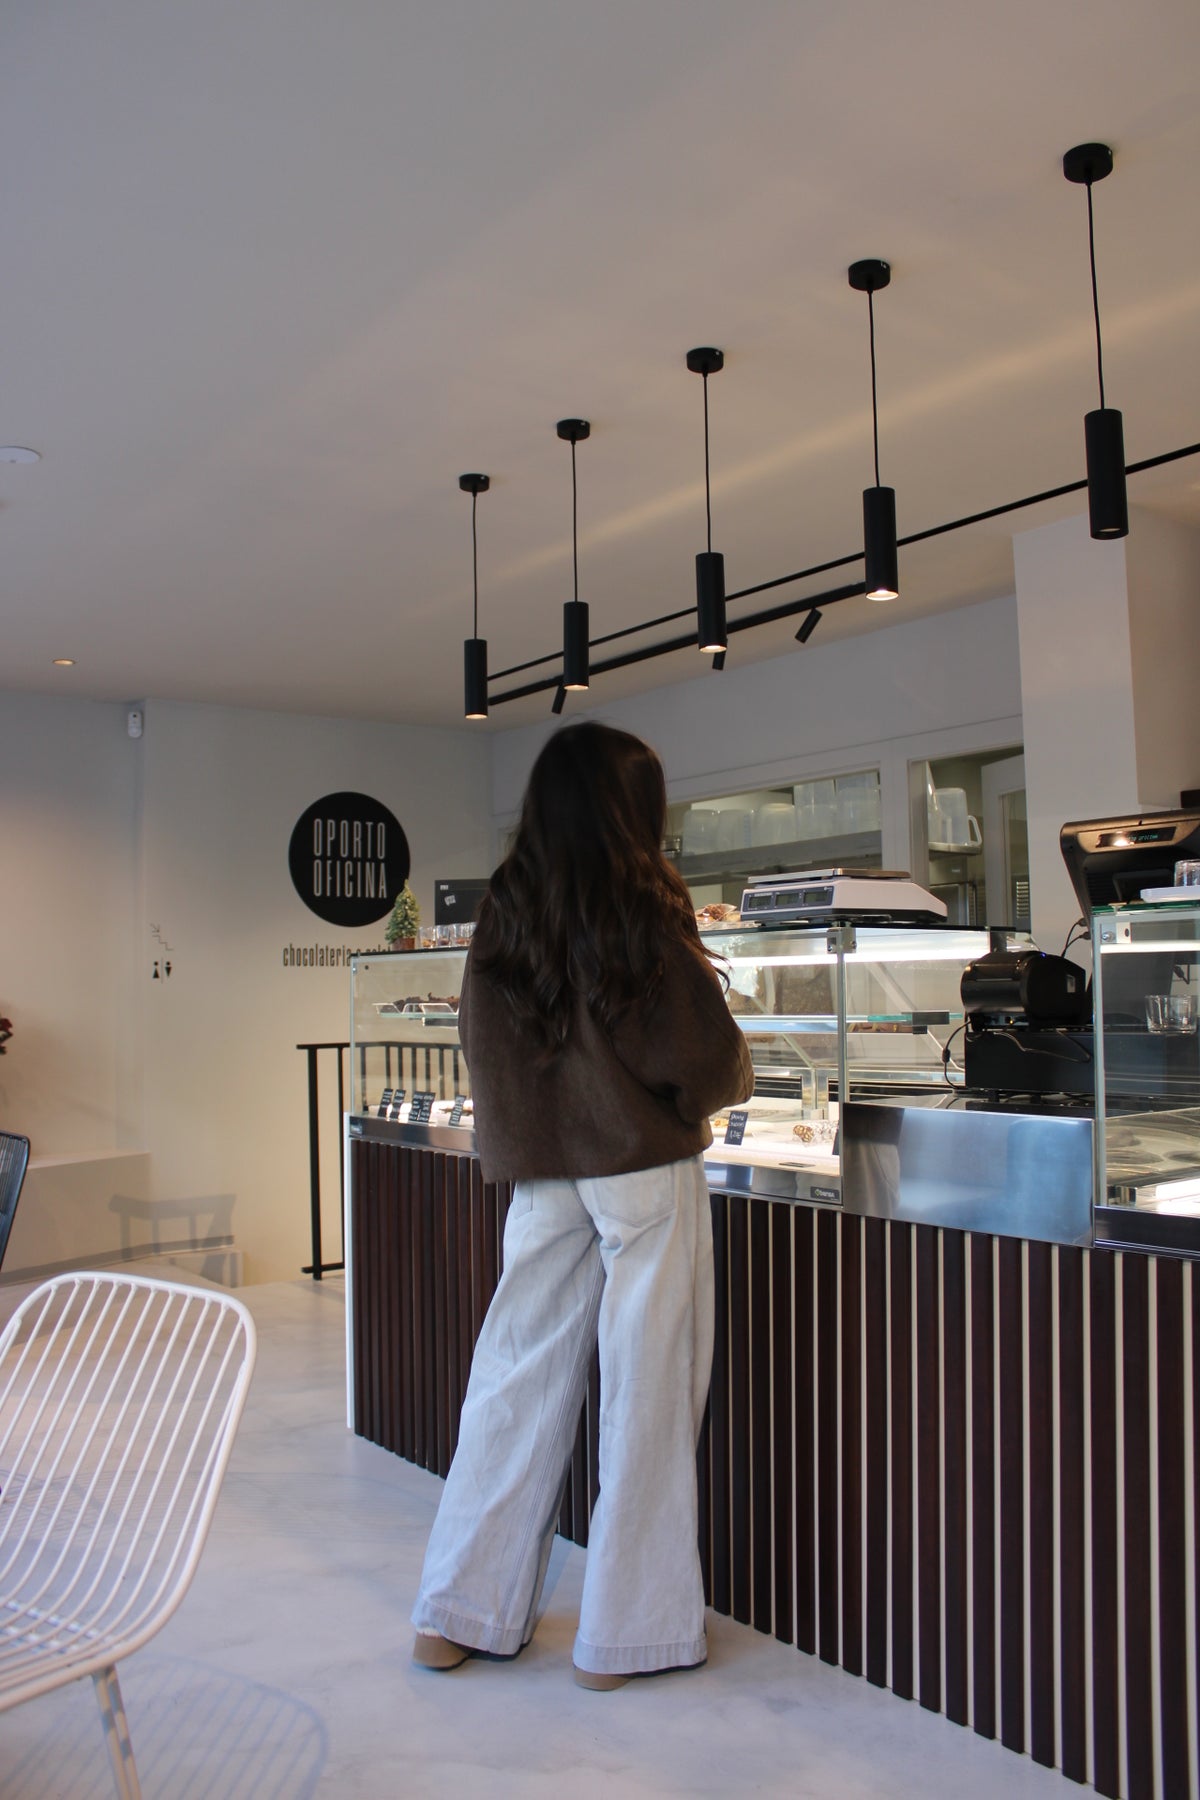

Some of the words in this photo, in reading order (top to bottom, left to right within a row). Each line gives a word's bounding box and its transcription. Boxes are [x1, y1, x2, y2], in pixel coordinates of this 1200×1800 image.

[313, 818, 386, 859] OPORTO
[313, 859, 388, 899] OFICINA
[282, 943, 351, 967] chocolateria
